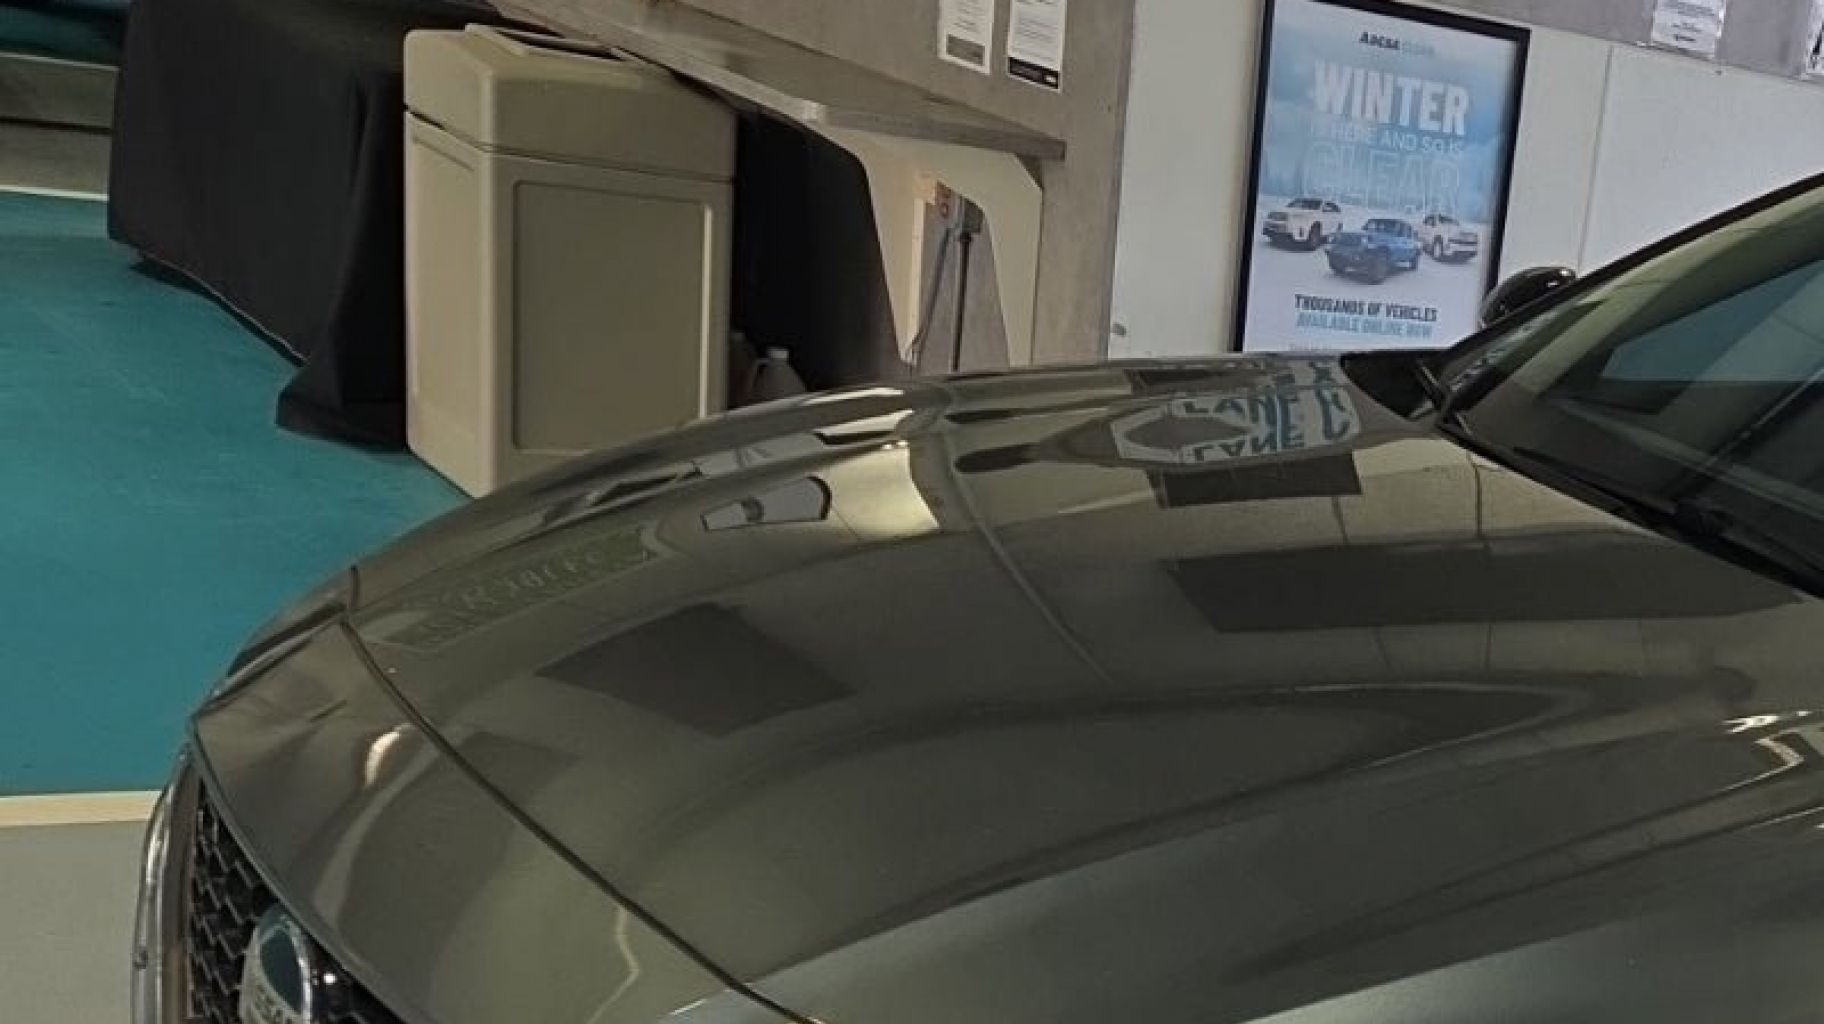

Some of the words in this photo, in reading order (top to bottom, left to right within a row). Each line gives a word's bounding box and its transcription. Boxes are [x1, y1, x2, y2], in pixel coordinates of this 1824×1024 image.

[1314, 60, 1469, 136] WINTER
[1381, 132, 1417, 151] AND
[1295, 294, 1364, 315] THOUSANDS
[1367, 300, 1381, 316] OF
[1385, 302, 1438, 322] VEHICLES
[1296, 313, 1360, 334] AVAILABLE
